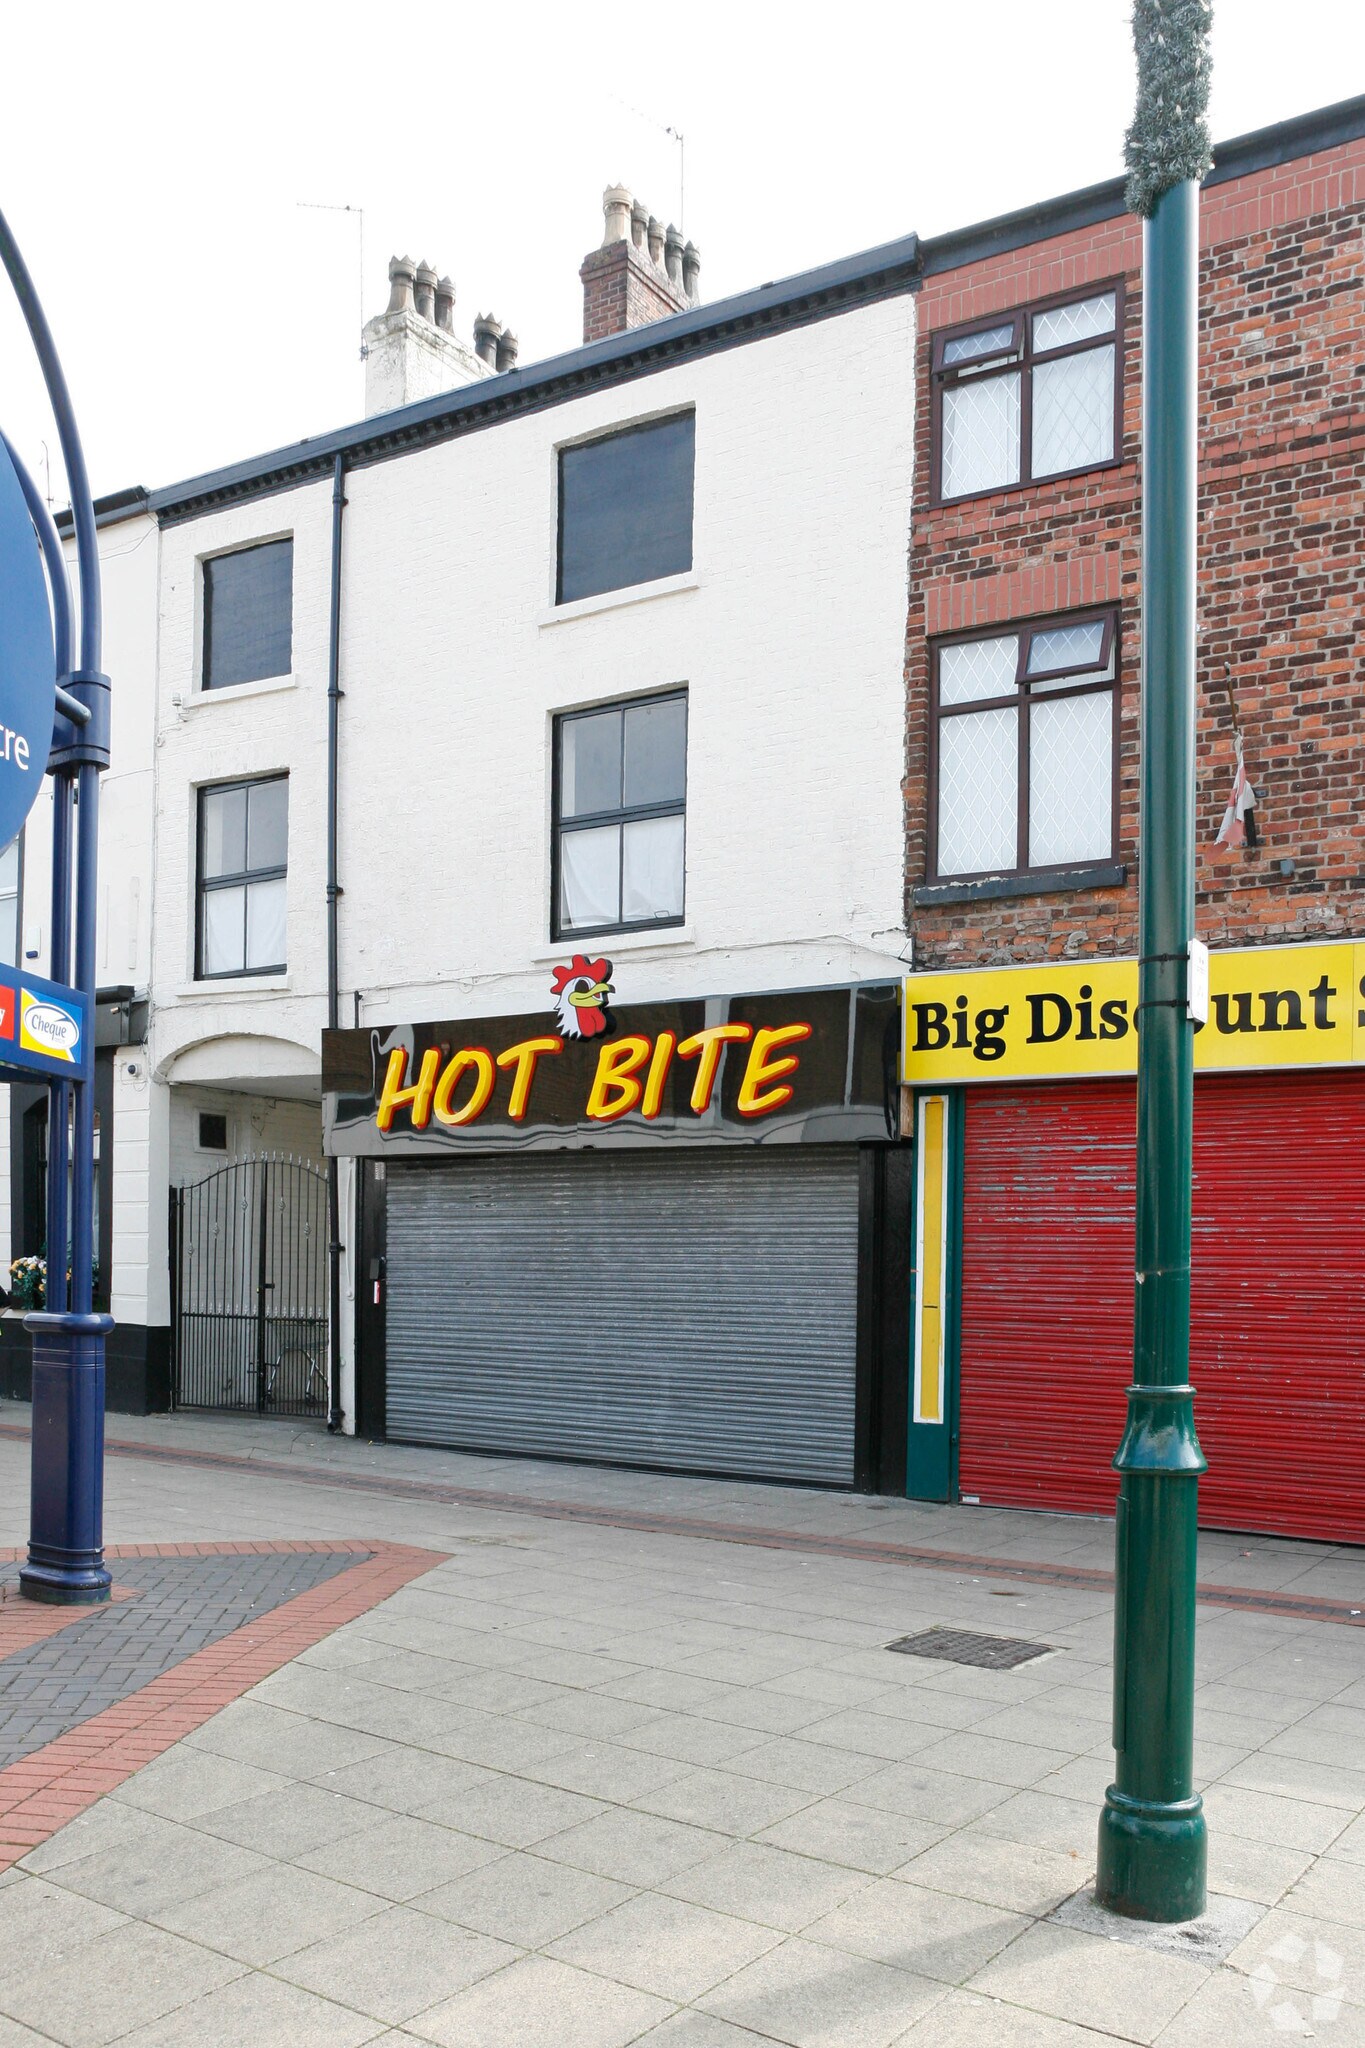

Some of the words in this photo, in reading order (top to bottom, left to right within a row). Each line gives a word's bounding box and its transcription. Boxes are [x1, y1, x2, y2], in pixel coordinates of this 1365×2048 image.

[31, 1014, 67, 1040] Cheque
[912, 994, 1009, 1061] Big
[1025, 974, 1337, 1044] Disunt
[375, 1034, 563, 1132] HOT
[586, 1021, 812, 1122] BITE
